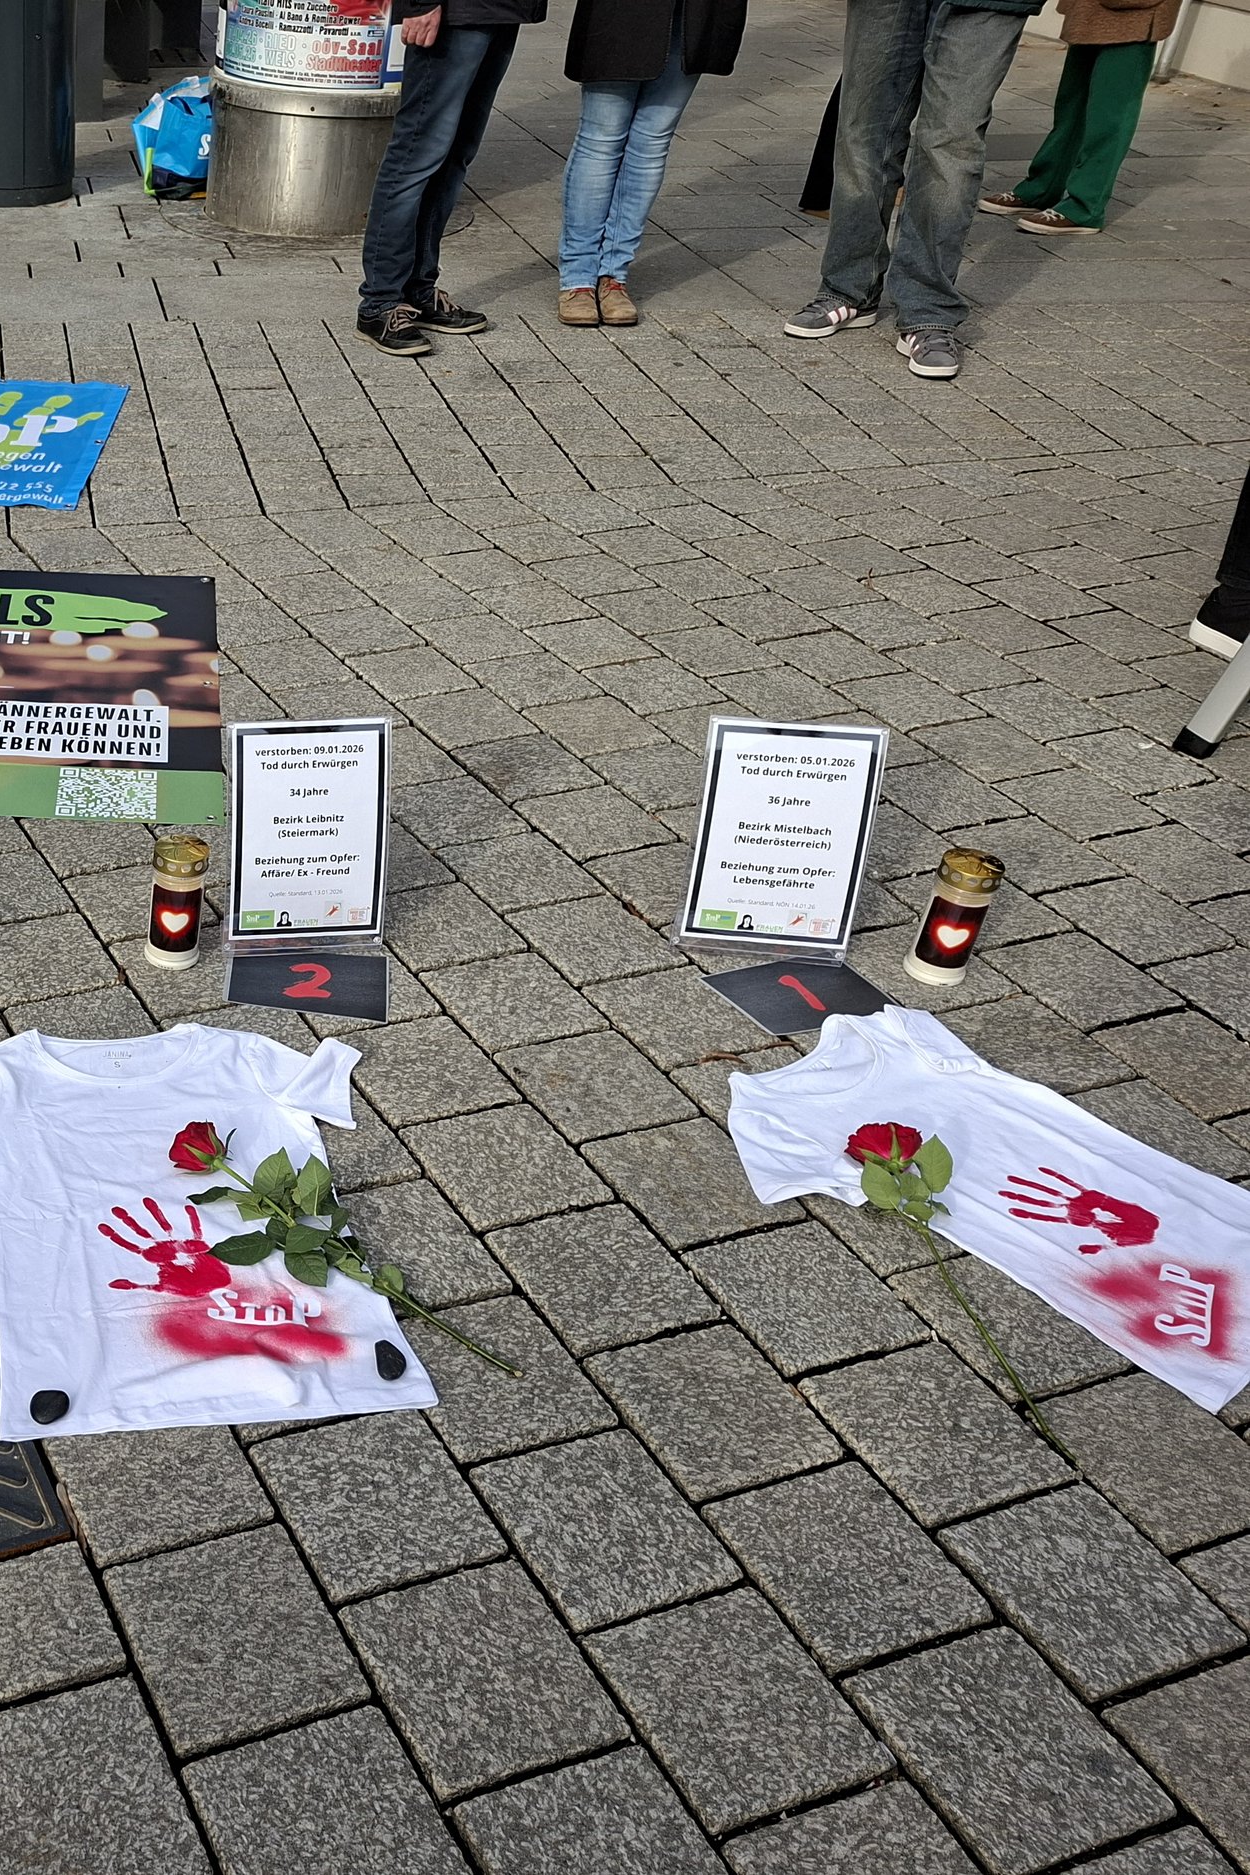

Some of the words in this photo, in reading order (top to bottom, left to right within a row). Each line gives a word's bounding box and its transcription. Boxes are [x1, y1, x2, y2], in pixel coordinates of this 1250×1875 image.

[306, 2, 338, 12] Zucchero
[242, 6, 254, 15] Laura
[255, 7, 275, 18] Pausini
[279, 11, 285, 19] Al
[287, 12, 303, 21] Bano
[304, 14, 310, 22] &
[312, 14, 338, 24] Romina
[339, 16, 361, 25] Power
[279, 22, 313, 34] Ramazzotti
[319, 26, 349, 36] Pavarotti
[264, 32, 297, 52] RIED
[264, 49, 296, 69] WELS
[23, 481, 54, 493] 555
[25, 720, 108, 738] FRAUEN
[117, 724, 162, 739] UND
[61, 737, 162, 757] KÖNNEN!
[254, 746, 312, 757] verstorben:
[313, 744, 364, 755] 09.01.2026
[260, 761, 279, 770] Tod
[281, 760, 310, 770] durch
[312, 758, 358, 770] Erwürgen
[736, 752, 798, 765] verstorben:
[800, 755, 856, 768] 05.01.2026
[740, 765, 760, 775] Tod
[762, 766, 794, 778] durch
[796, 769, 848, 783] Erwürgen
[289, 788, 301, 797] 34
[302, 787, 330, 798] Jahre
[767, 795, 781, 805] 36
[781, 796, 811, 808] Jahre
[273, 815, 303, 825] Bezirk
[306, 814, 345, 824] Leibnitz
[277, 827, 339, 840] (Steiermark)
[738, 821, 771, 832] Bezirk
[773, 824, 832, 836] Mistelbach
[733, 834, 832, 851] (Niederösterreich)
[254, 856, 305, 869] Beziehung
[306, 856, 328, 864] zum
[329, 853, 360, 865] Opfer:
[260, 868, 295, 878] Affäre/
[297, 868, 309, 877] Ex
[316, 866, 350, 876] Freund
[720, 860, 775, 875] Beziehung
[776, 866, 800, 876] zum
[802, 866, 836, 878] Opfer:
[732, 875, 815, 890] Lebensgefährte
[281, 962, 333, 999] 2
[777, 974, 828, 1011] 1
